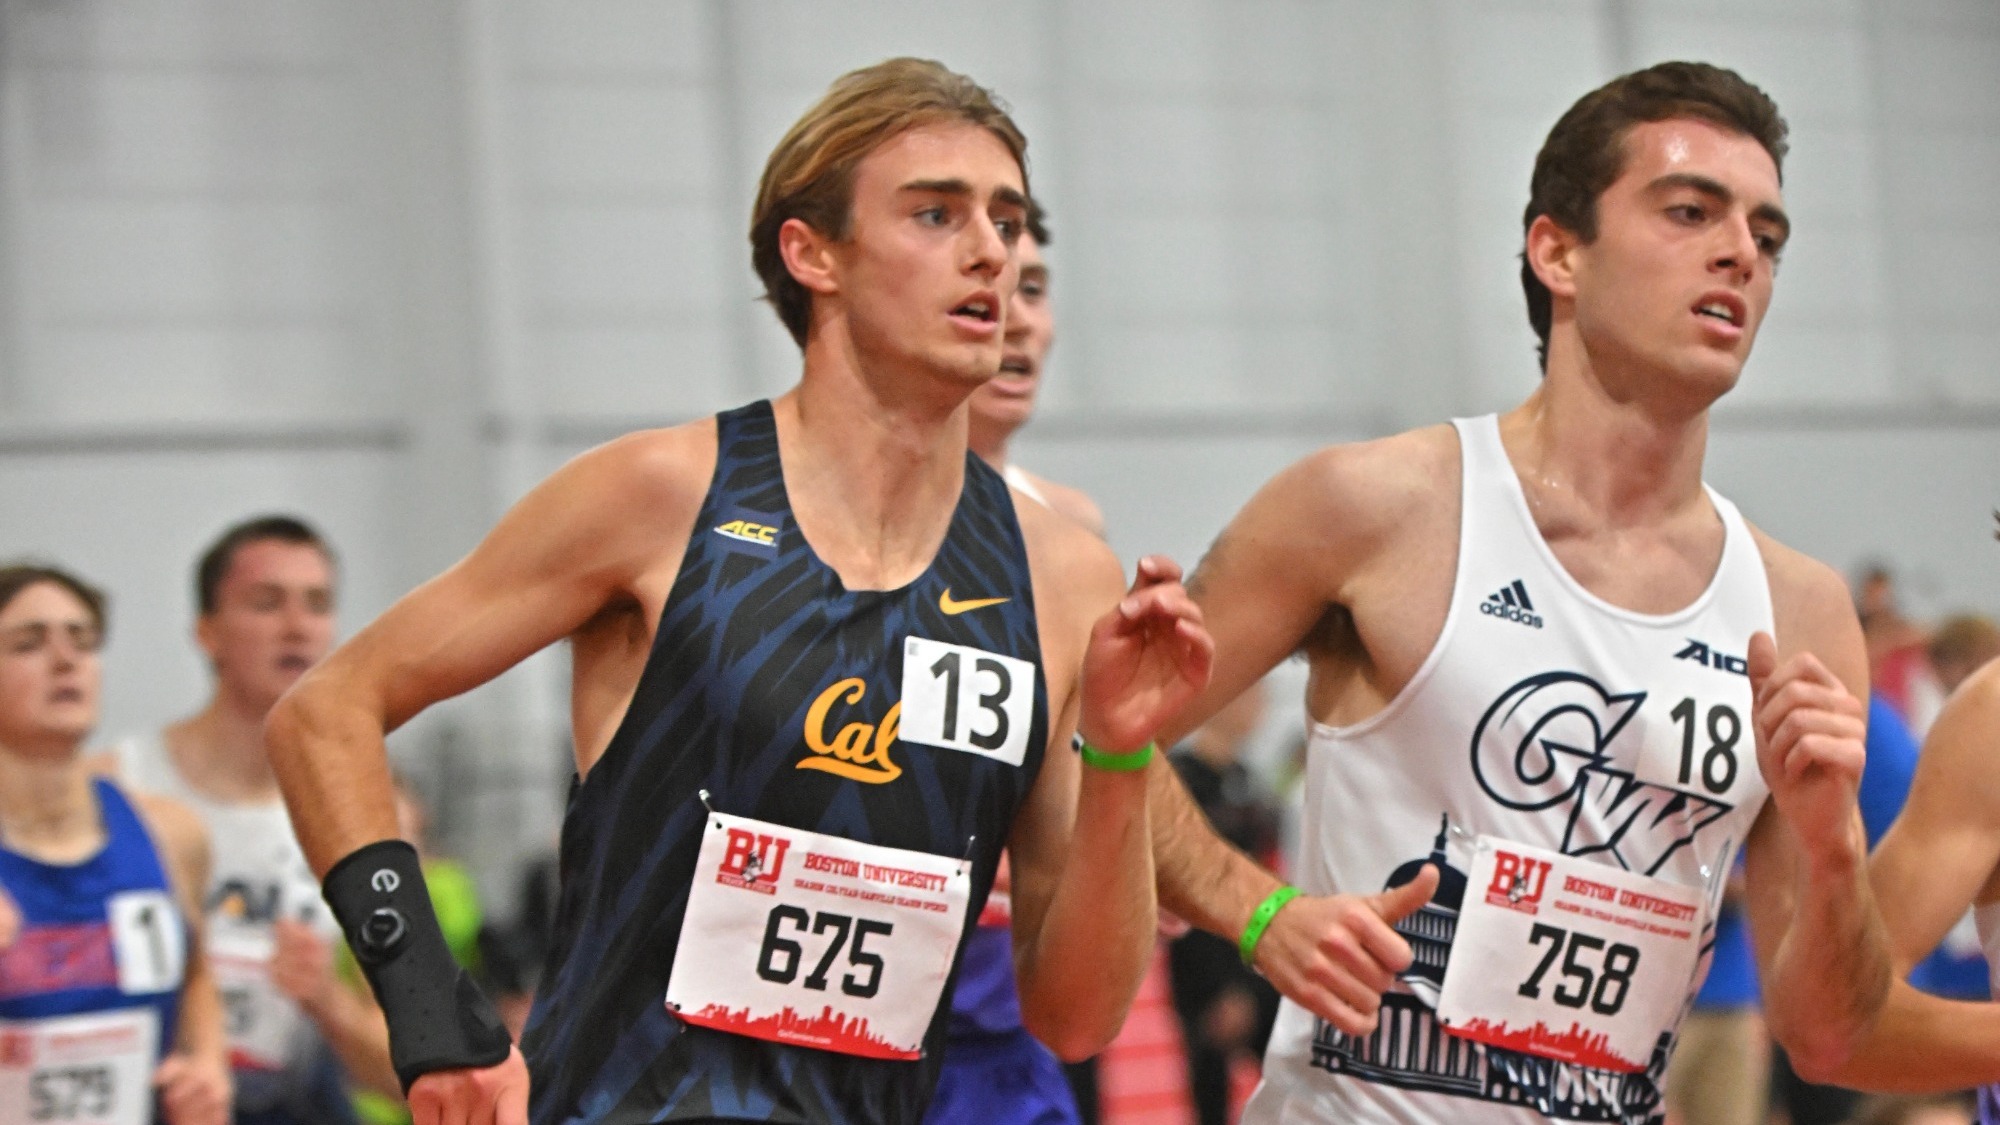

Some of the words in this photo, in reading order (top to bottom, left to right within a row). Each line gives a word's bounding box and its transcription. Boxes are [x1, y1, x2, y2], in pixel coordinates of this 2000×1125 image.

[719, 519, 780, 543] ACC
[1480, 600, 1543, 629] adidas
[796, 677, 903, 784] Cal
[929, 651, 1012, 752] 13
[1669, 697, 1742, 795] 18
[720, 828, 791, 882] BU
[803, 852, 861, 878] BOSTON
[863, 863, 948, 893] UNIVERSITY
[1488, 850, 1552, 904] BU
[756, 904, 894, 999] 675
[1518, 922, 1640, 1016] 758
